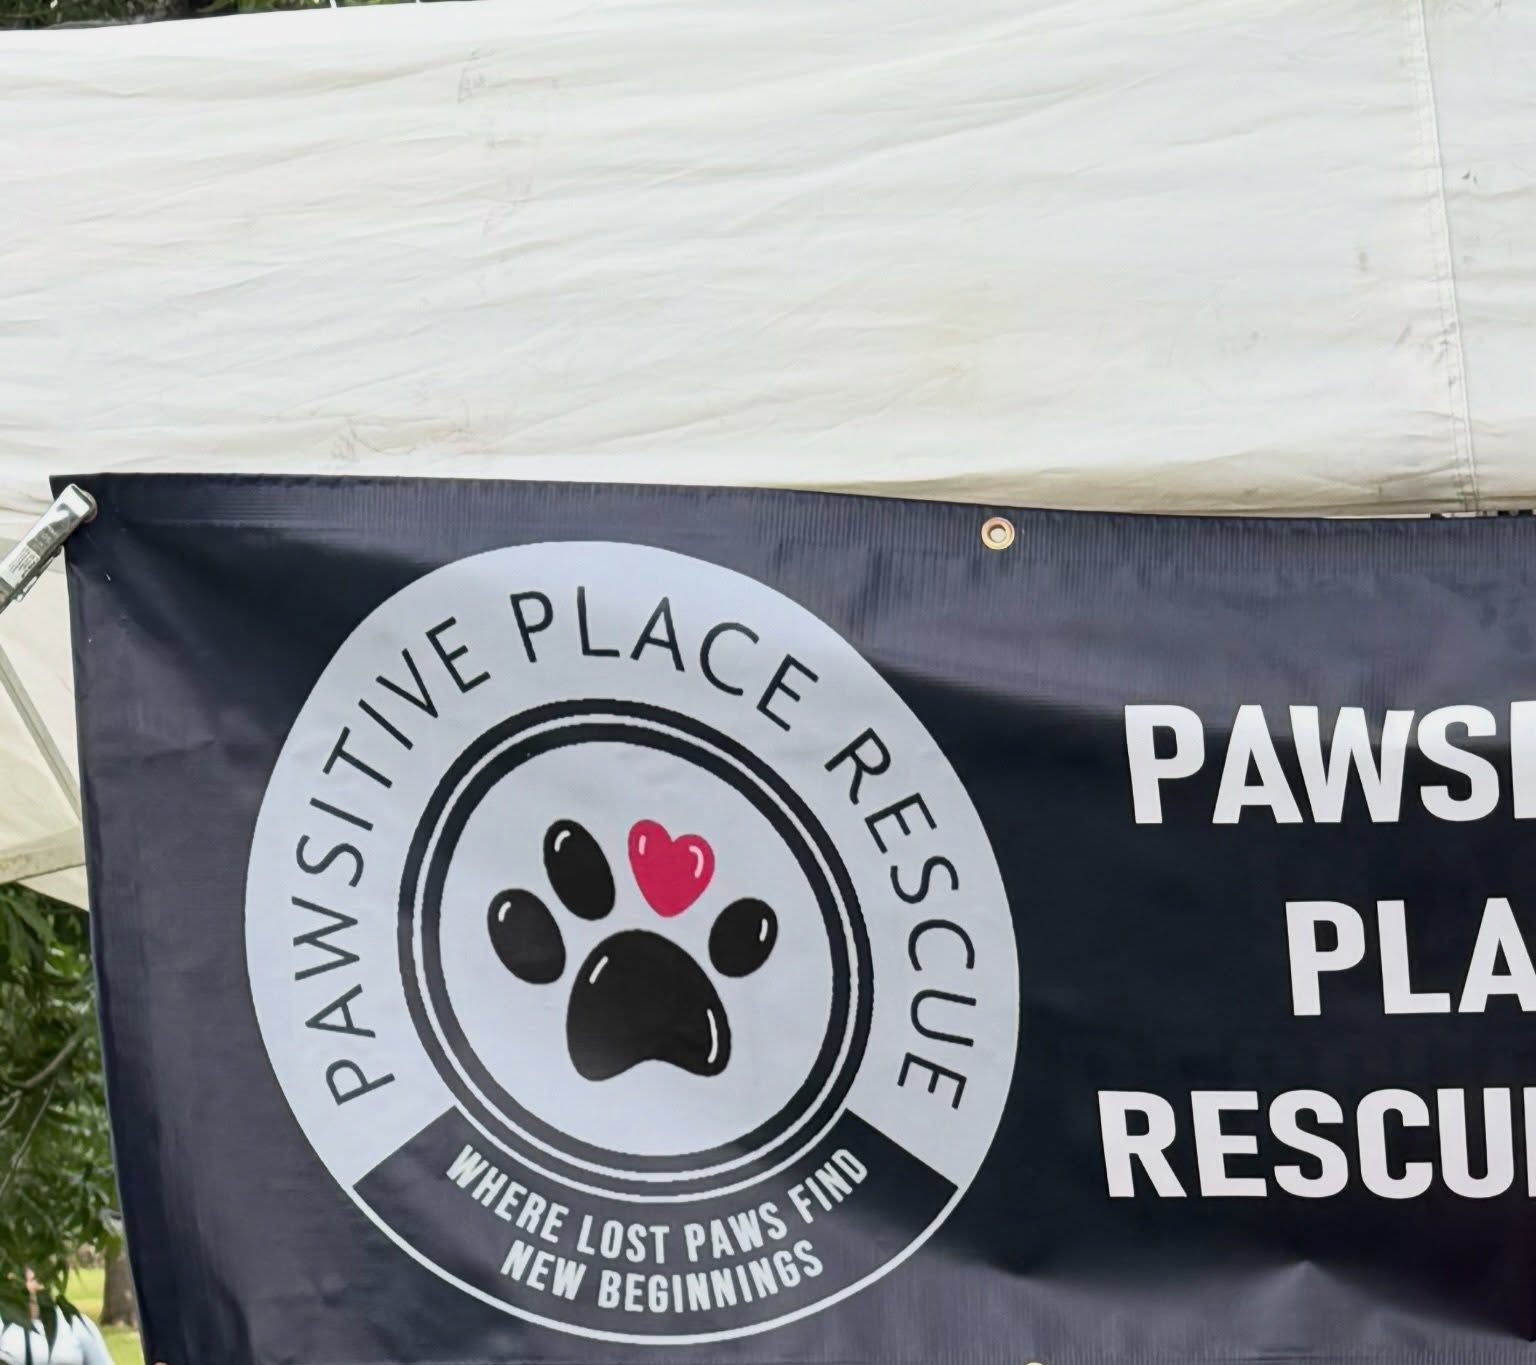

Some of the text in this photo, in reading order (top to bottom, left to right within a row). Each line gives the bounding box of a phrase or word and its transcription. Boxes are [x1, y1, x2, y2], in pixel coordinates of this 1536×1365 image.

[291, 585, 978, 1111] PAWSITIVE PLACE RESCUE
[445, 1143, 870, 1266] WHERE LOST PAWS FIND
[500, 1239, 825, 1313] NEW BEGINNINGS
